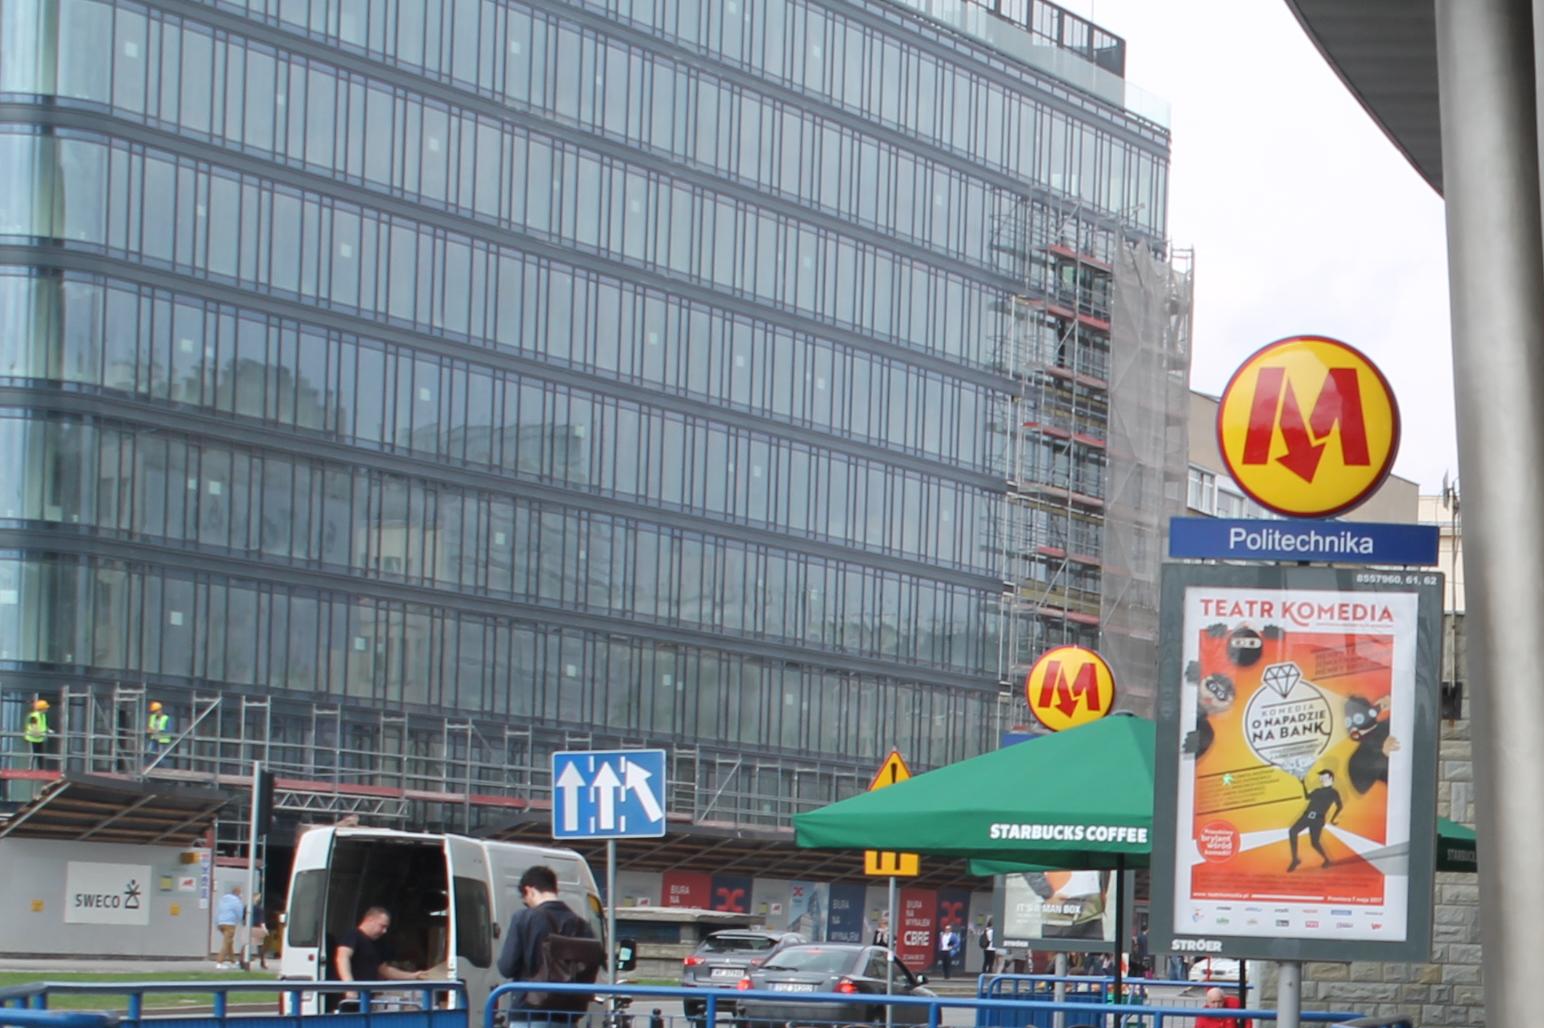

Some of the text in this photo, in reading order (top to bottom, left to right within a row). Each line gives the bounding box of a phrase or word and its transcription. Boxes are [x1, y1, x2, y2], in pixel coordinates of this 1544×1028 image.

[1229, 527, 1374, 554] Politechnika
[1423, 576, 1437, 585] 62
[1200, 599, 1394, 626] TEATR KOMEDIA
[1252, 709, 1326, 729] O NAPADZIE
[1253, 721, 1331, 742] NA BANK
[990, 823, 1148, 843] STARBUCKS COFFEE
[75, 893, 121, 908] SWECO
[1042, 904, 1061, 914] MAN
[1063, 904, 1081, 915] BOX
[904, 930, 930, 946] CBRE
